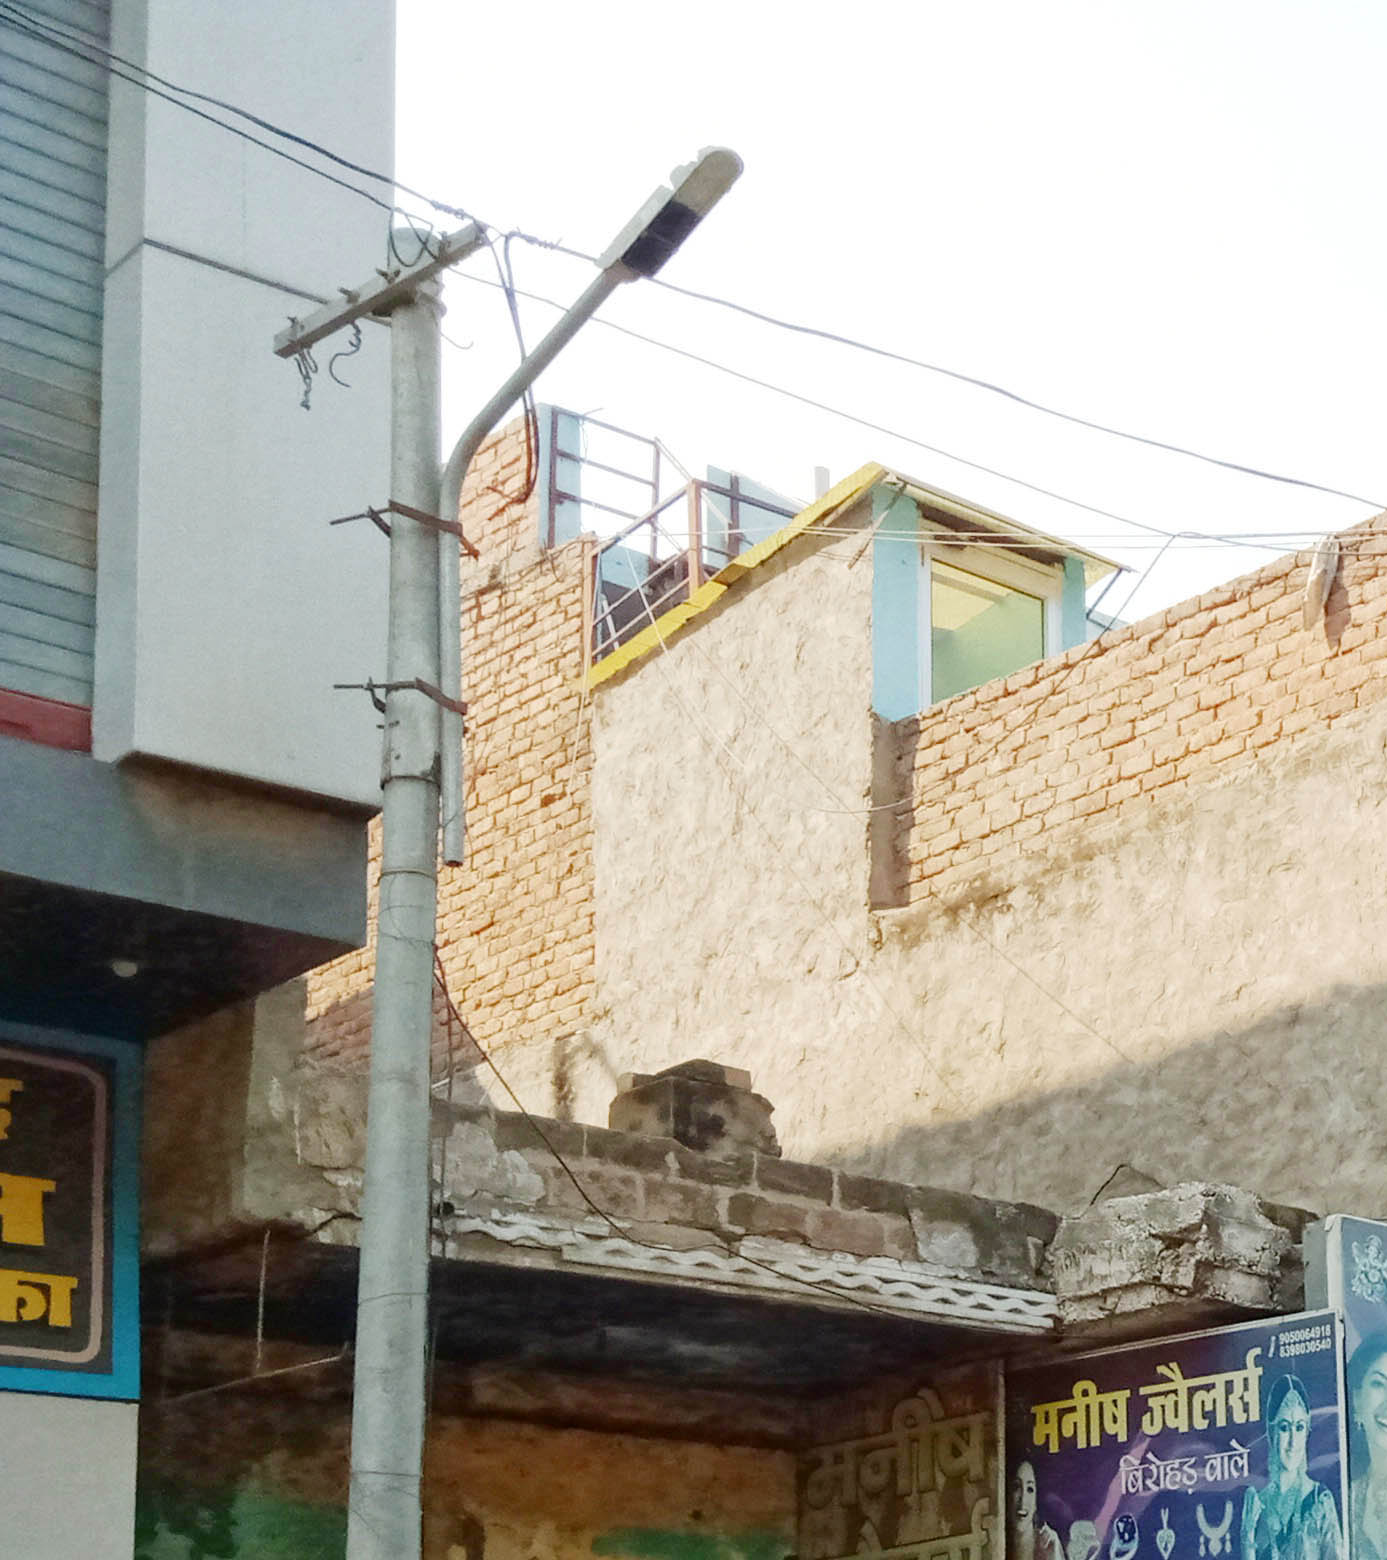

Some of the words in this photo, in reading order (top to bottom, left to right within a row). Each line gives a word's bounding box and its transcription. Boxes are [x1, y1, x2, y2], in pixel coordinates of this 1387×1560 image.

[1278, 1326, 1332, 1345] 9050064918
[1278, 1338, 1333, 1359] 8398030540
[1030, 1378, 1130, 1455] मनीष
[1140, 1347, 1263, 1440] ज्वैलर्स
[1203, 1439, 1250, 1482] वाले
